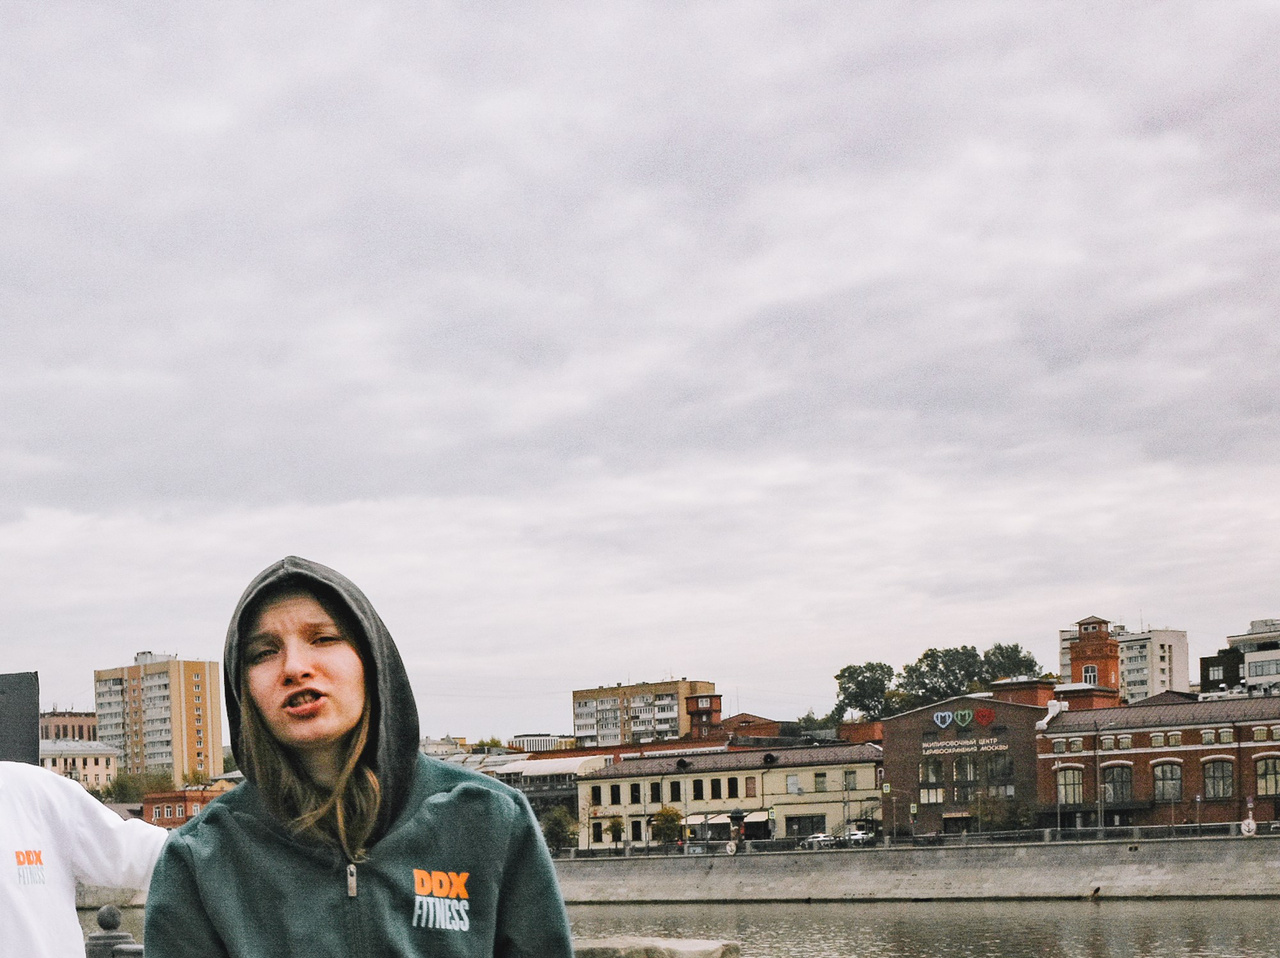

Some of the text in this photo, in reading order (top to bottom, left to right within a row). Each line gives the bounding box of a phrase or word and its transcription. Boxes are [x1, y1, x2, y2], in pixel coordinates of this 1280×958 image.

[15, 850, 44, 866] DDX
[413, 868, 470, 899] DDX
[412, 895, 470, 931] FITNESS
